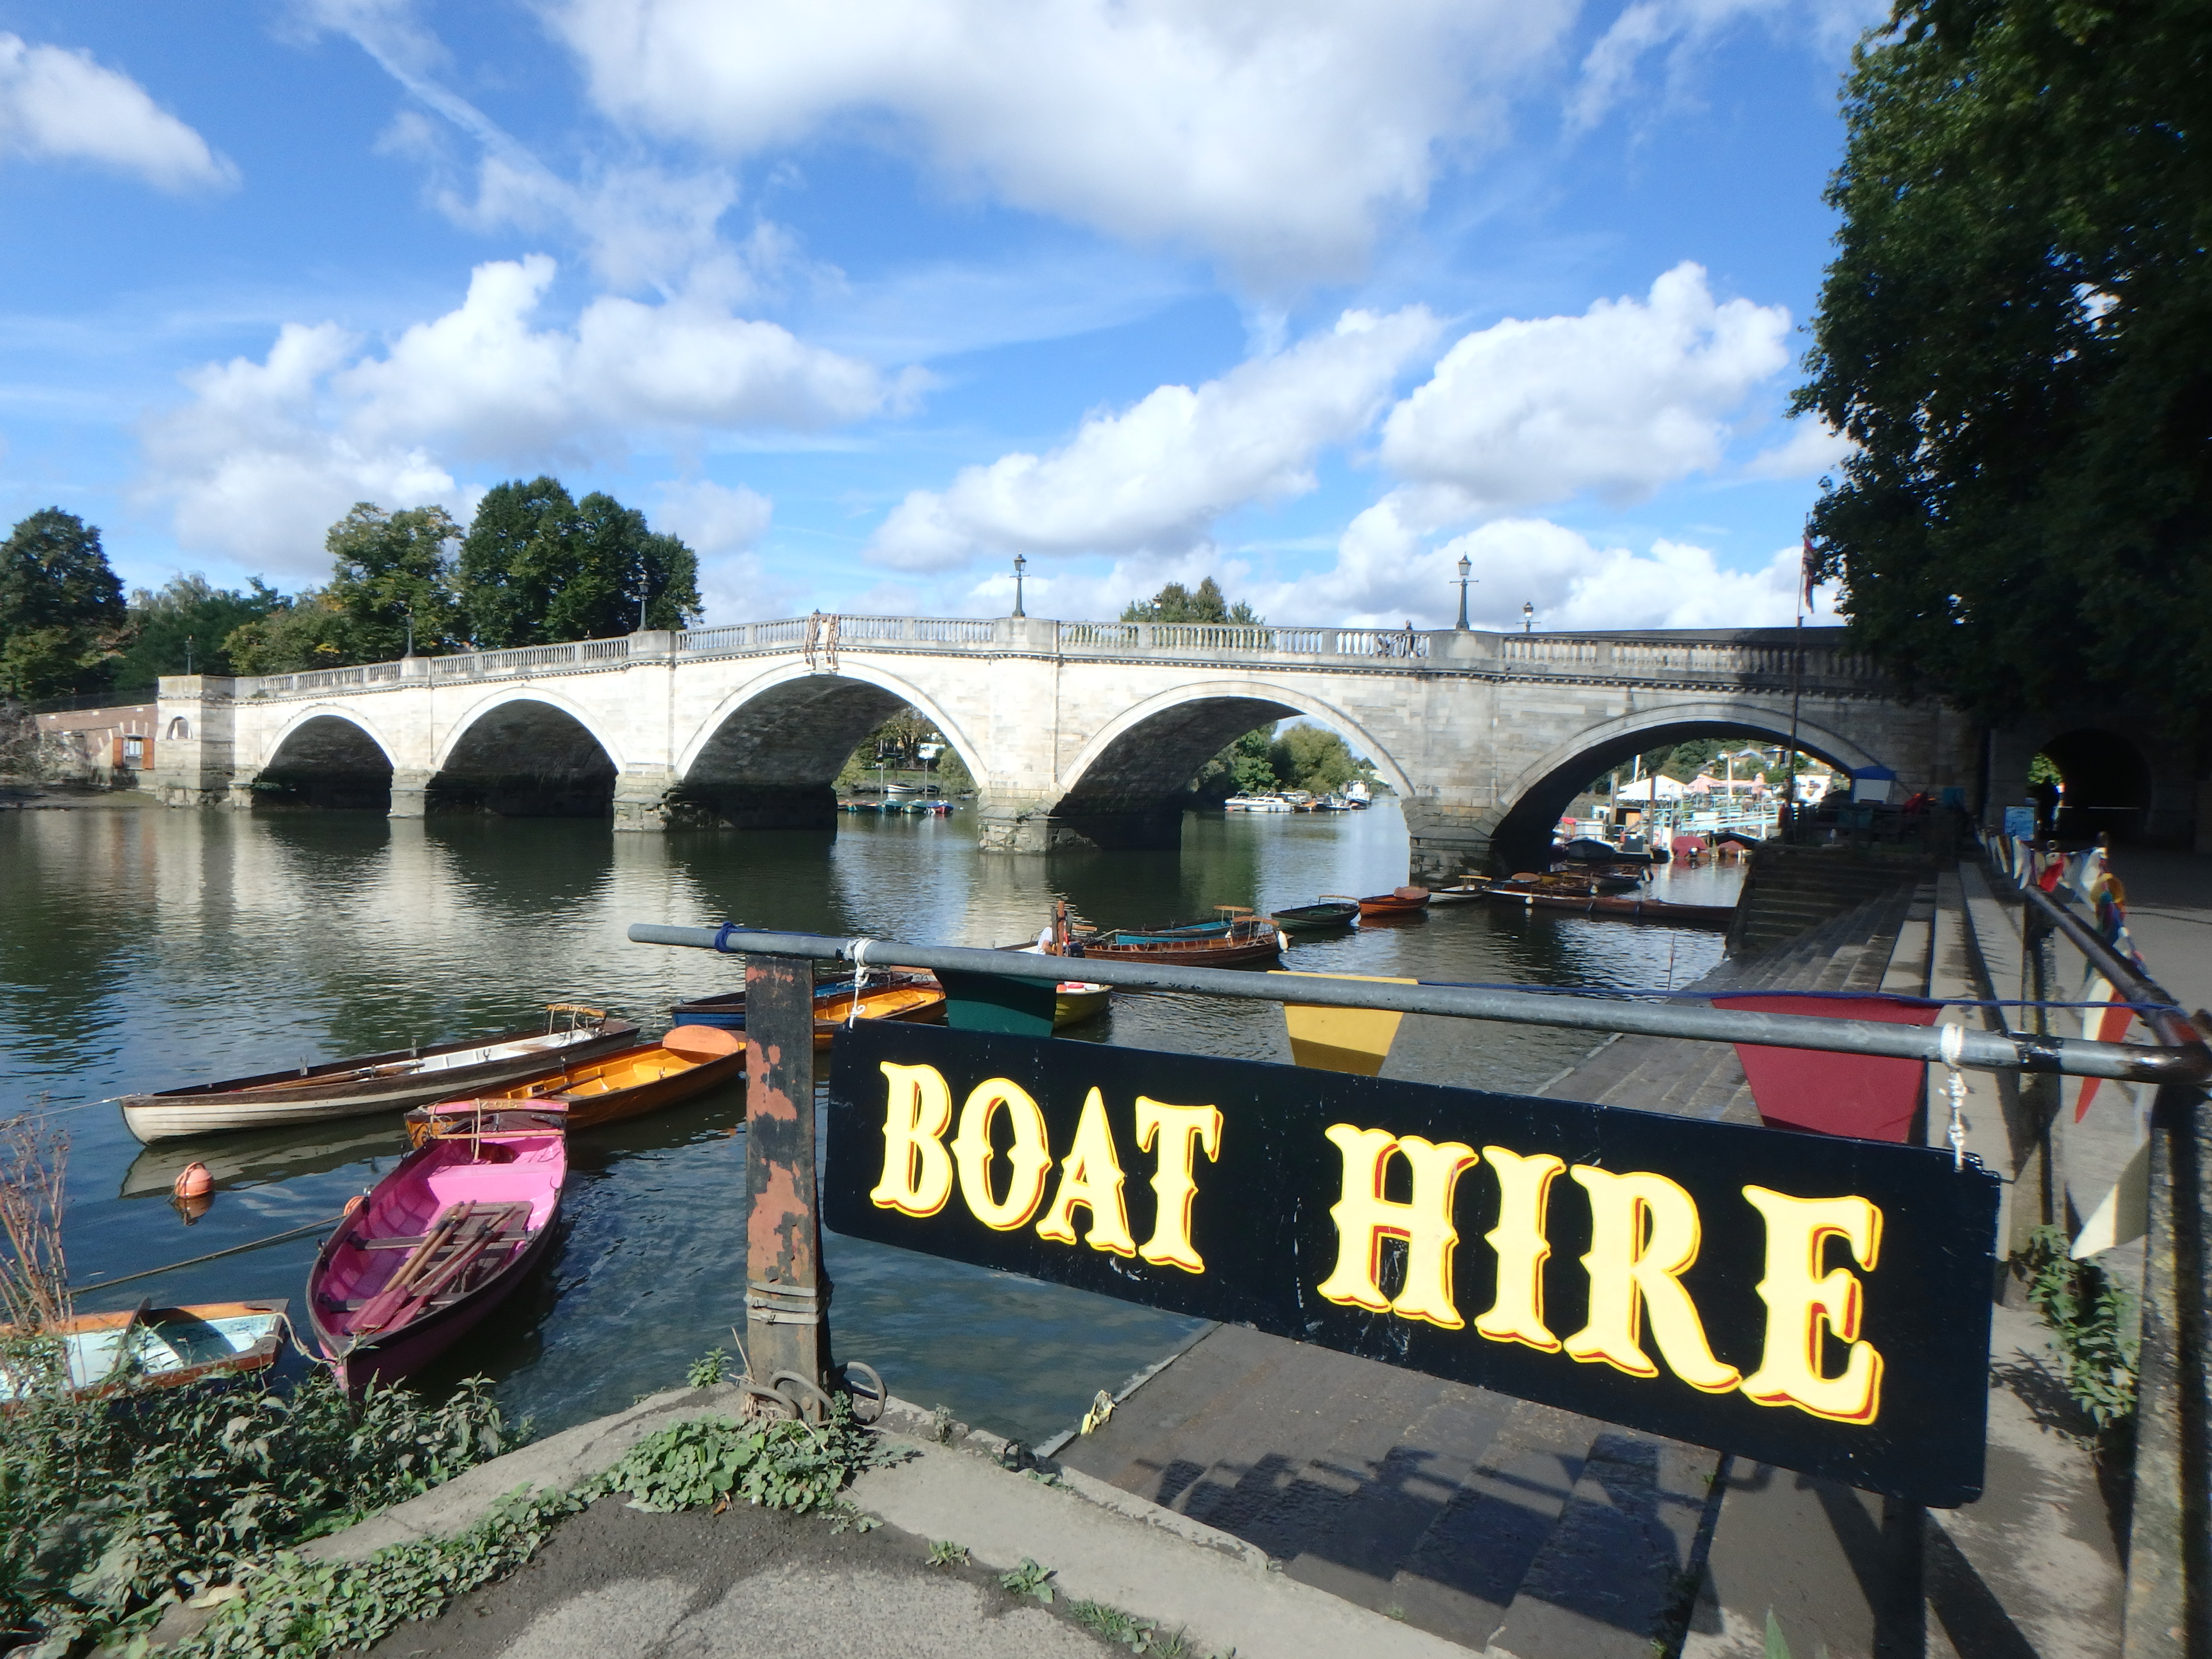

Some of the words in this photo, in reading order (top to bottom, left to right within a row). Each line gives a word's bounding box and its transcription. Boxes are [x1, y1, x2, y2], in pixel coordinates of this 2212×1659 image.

[481, 1099, 517, 1109] ZOE
[869, 1060, 1225, 1275] BOAT
[1316, 1122, 1885, 1426] HIRE
